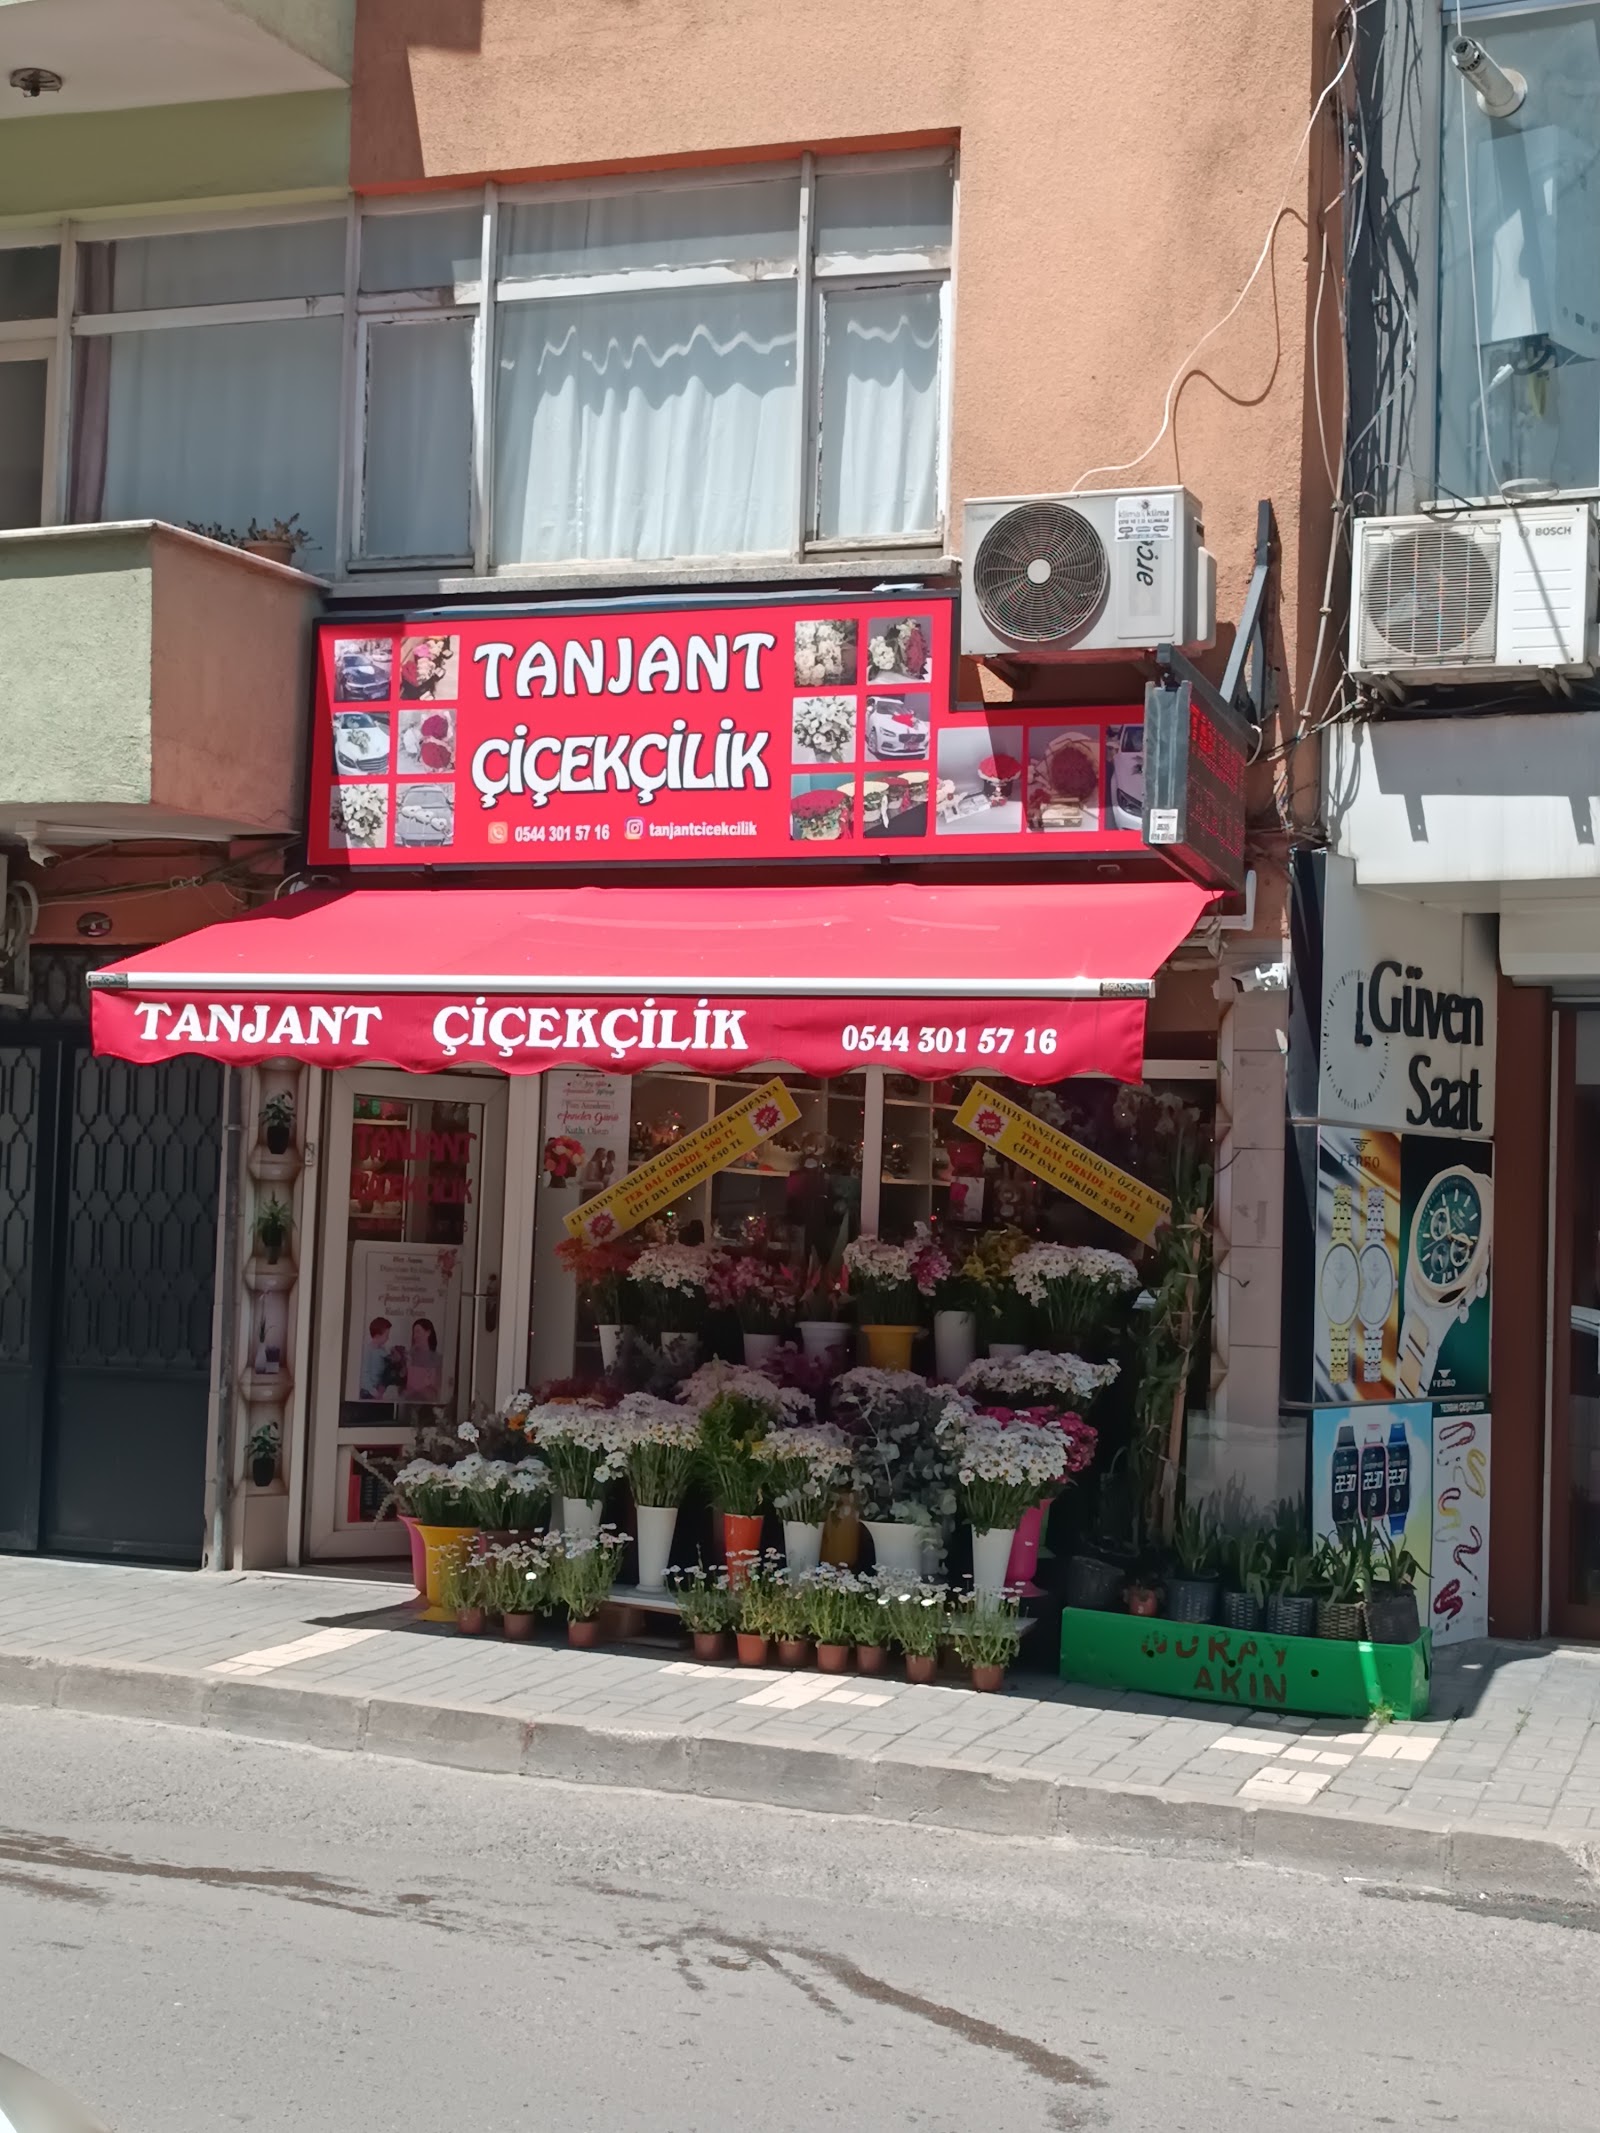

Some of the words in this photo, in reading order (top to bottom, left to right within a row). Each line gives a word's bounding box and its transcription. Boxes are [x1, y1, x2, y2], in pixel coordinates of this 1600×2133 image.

[1535, 526, 1572, 536] BOSCH
[473, 632, 776, 699] TANJANT
[471, 717, 770, 809] ÇİÇEKÇİLİK
[514, 825, 546, 843] 0544
[548, 825, 571, 842] 301
[573, 824, 590, 841] 57
[594, 823, 610, 841] 16
[649, 820, 757, 840] tanjantcicekcilik
[134, 1001, 383, 1046] TANJANT
[432, 996, 748, 1058] ÇİÇEKÇİLİK
[841, 1024, 909, 1052] 0544
[917, 1026, 967, 1053] 301
[977, 1027, 1013, 1054] 57
[1023, 1027, 1057, 1054] 16
[1368, 961, 1484, 1046] Güven
[1406, 1055, 1483, 1131] Saat
[1193, 1666, 1287, 1702] AKIN
